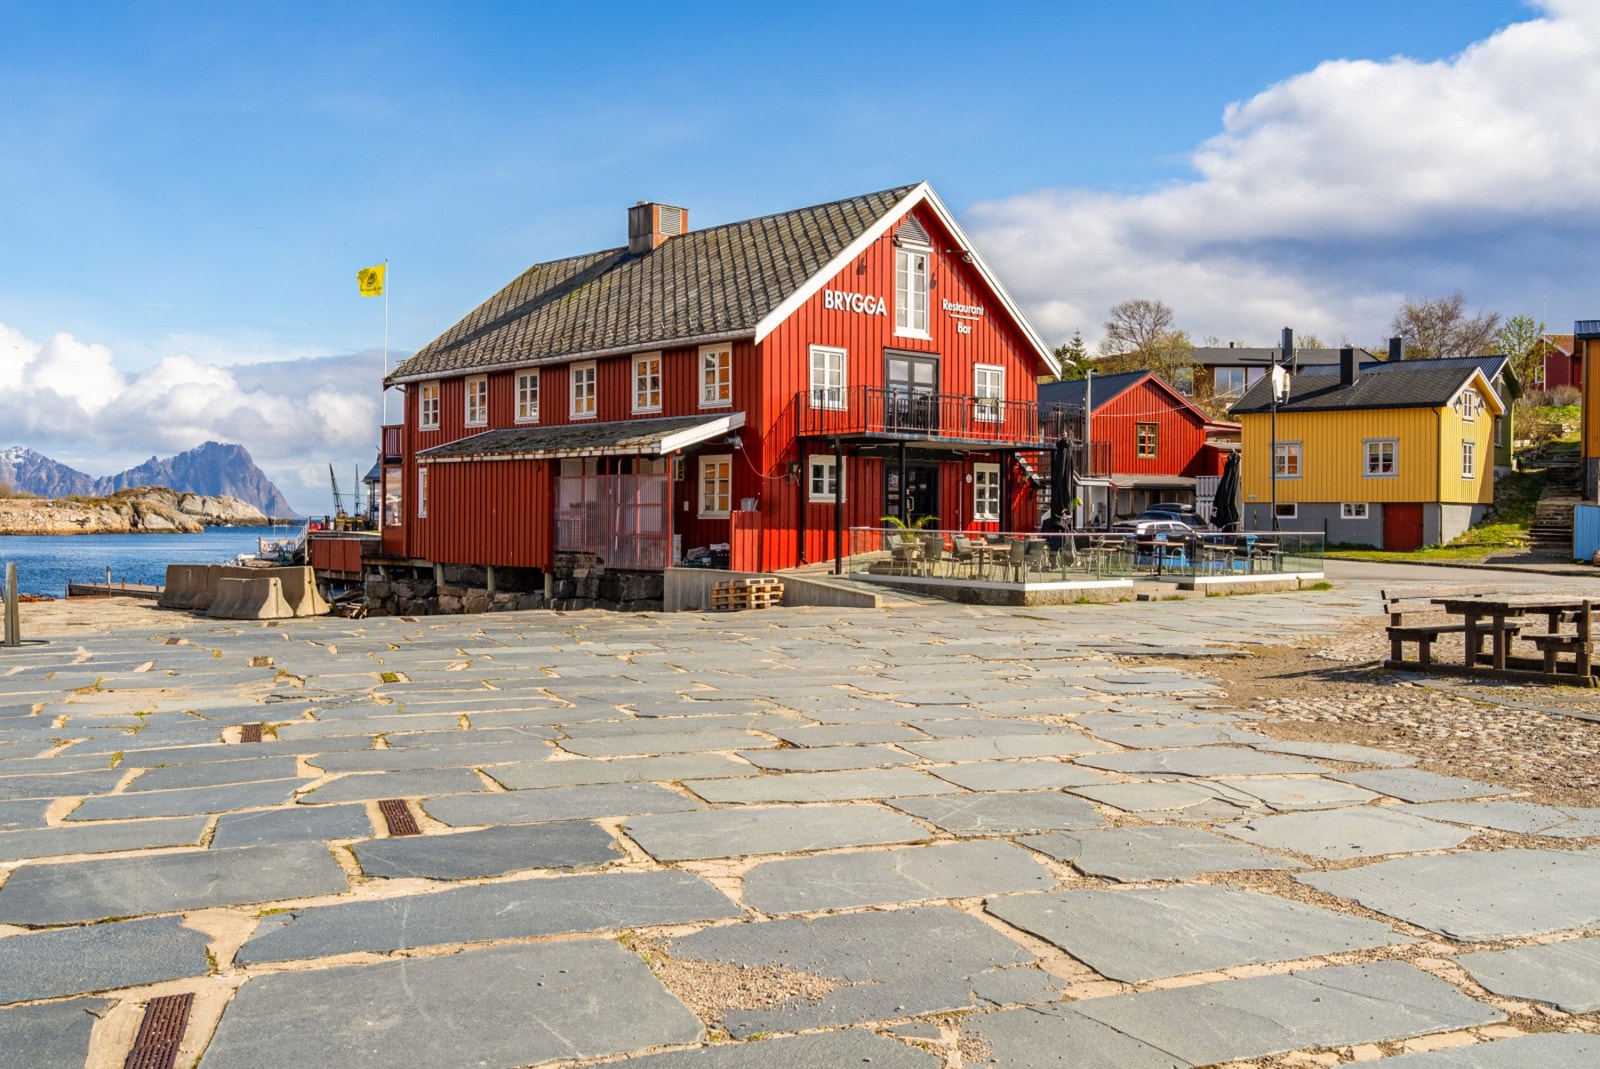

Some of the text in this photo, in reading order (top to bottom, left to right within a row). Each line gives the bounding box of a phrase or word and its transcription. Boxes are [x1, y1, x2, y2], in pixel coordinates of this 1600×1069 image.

[824, 289, 887, 317] BRYGGA
[942, 298, 985, 316] Restaurant
[957, 321, 972, 335] Bar
